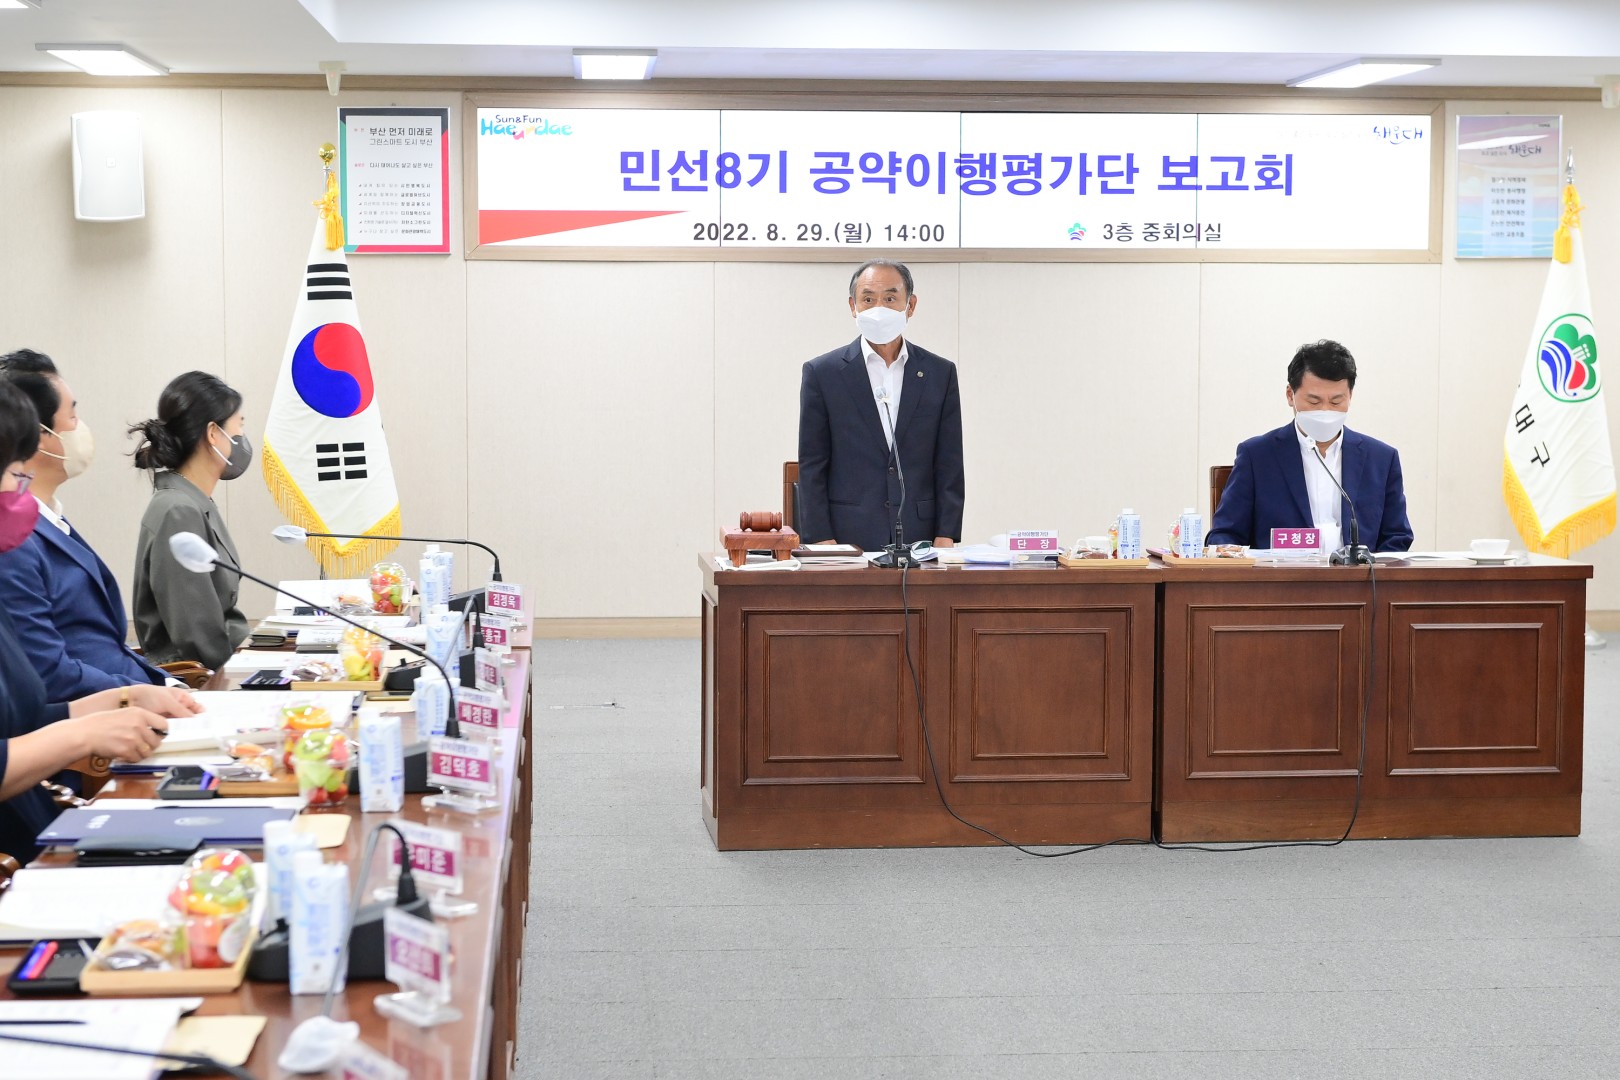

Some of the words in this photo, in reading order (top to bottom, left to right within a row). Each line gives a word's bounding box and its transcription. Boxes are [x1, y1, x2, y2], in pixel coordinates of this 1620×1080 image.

[495, 114, 542, 124] Sun&Fun
[369, 127, 386, 136] 부산
[389, 127, 405, 136] 먼저
[408, 127, 433, 136] 미래로
[619, 149, 788, 194] 민선8기
[808, 150, 1141, 197] 공약이행평가단
[1156, 152, 1295, 197] 보고회
[692, 222, 757, 241] 2022.
[766, 223, 787, 241] 8.
[883, 224, 946, 242] 14:00
[1101, 222, 1135, 243] 3층
[1141, 222, 1223, 243] 중회의실
[1277, 532, 1316, 545] 구청장
[481, 628, 502, 644] 홍규
